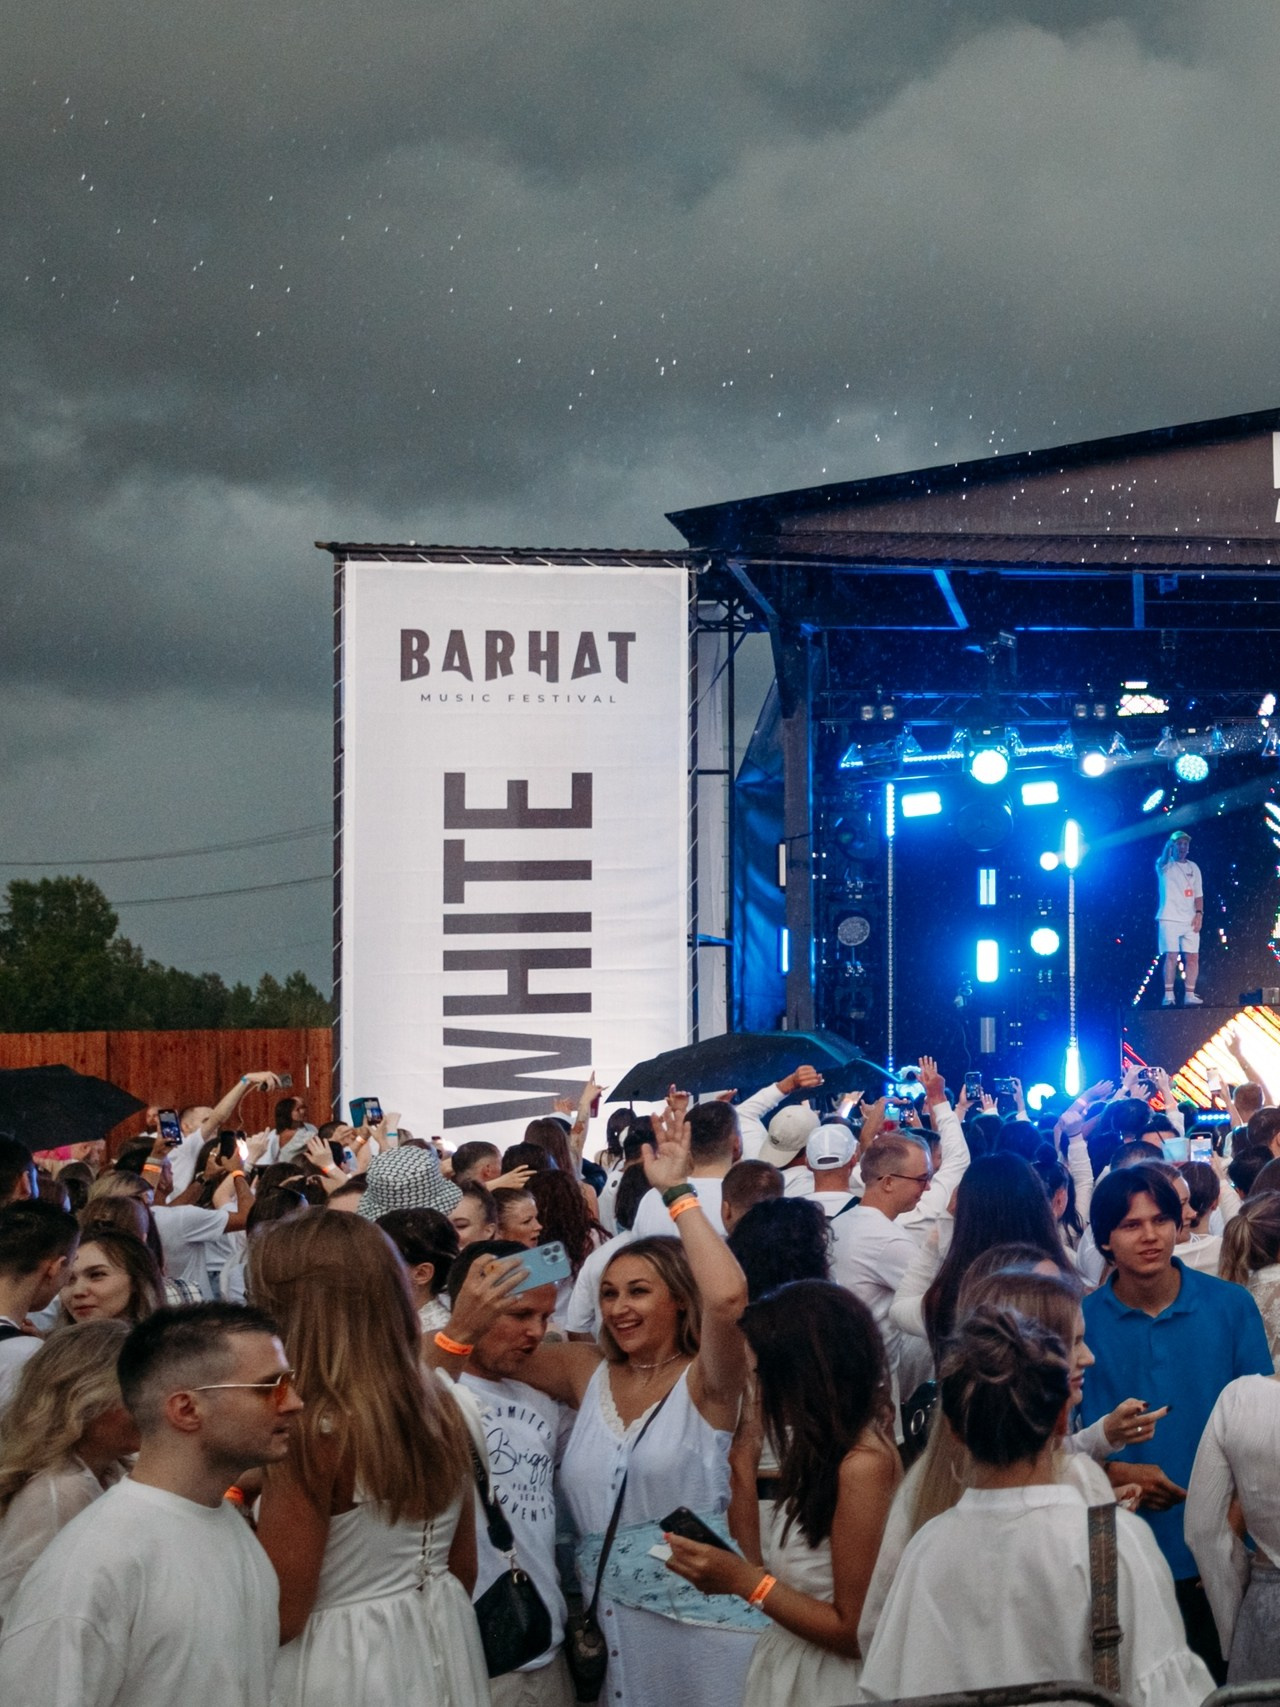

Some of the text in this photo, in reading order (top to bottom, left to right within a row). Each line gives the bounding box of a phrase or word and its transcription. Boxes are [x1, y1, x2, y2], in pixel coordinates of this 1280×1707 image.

[400, 629, 636, 684] BARHAT
[420, 693, 617, 704] MUSIC FESTIVAL
[443, 772, 592, 1129] WHITE
